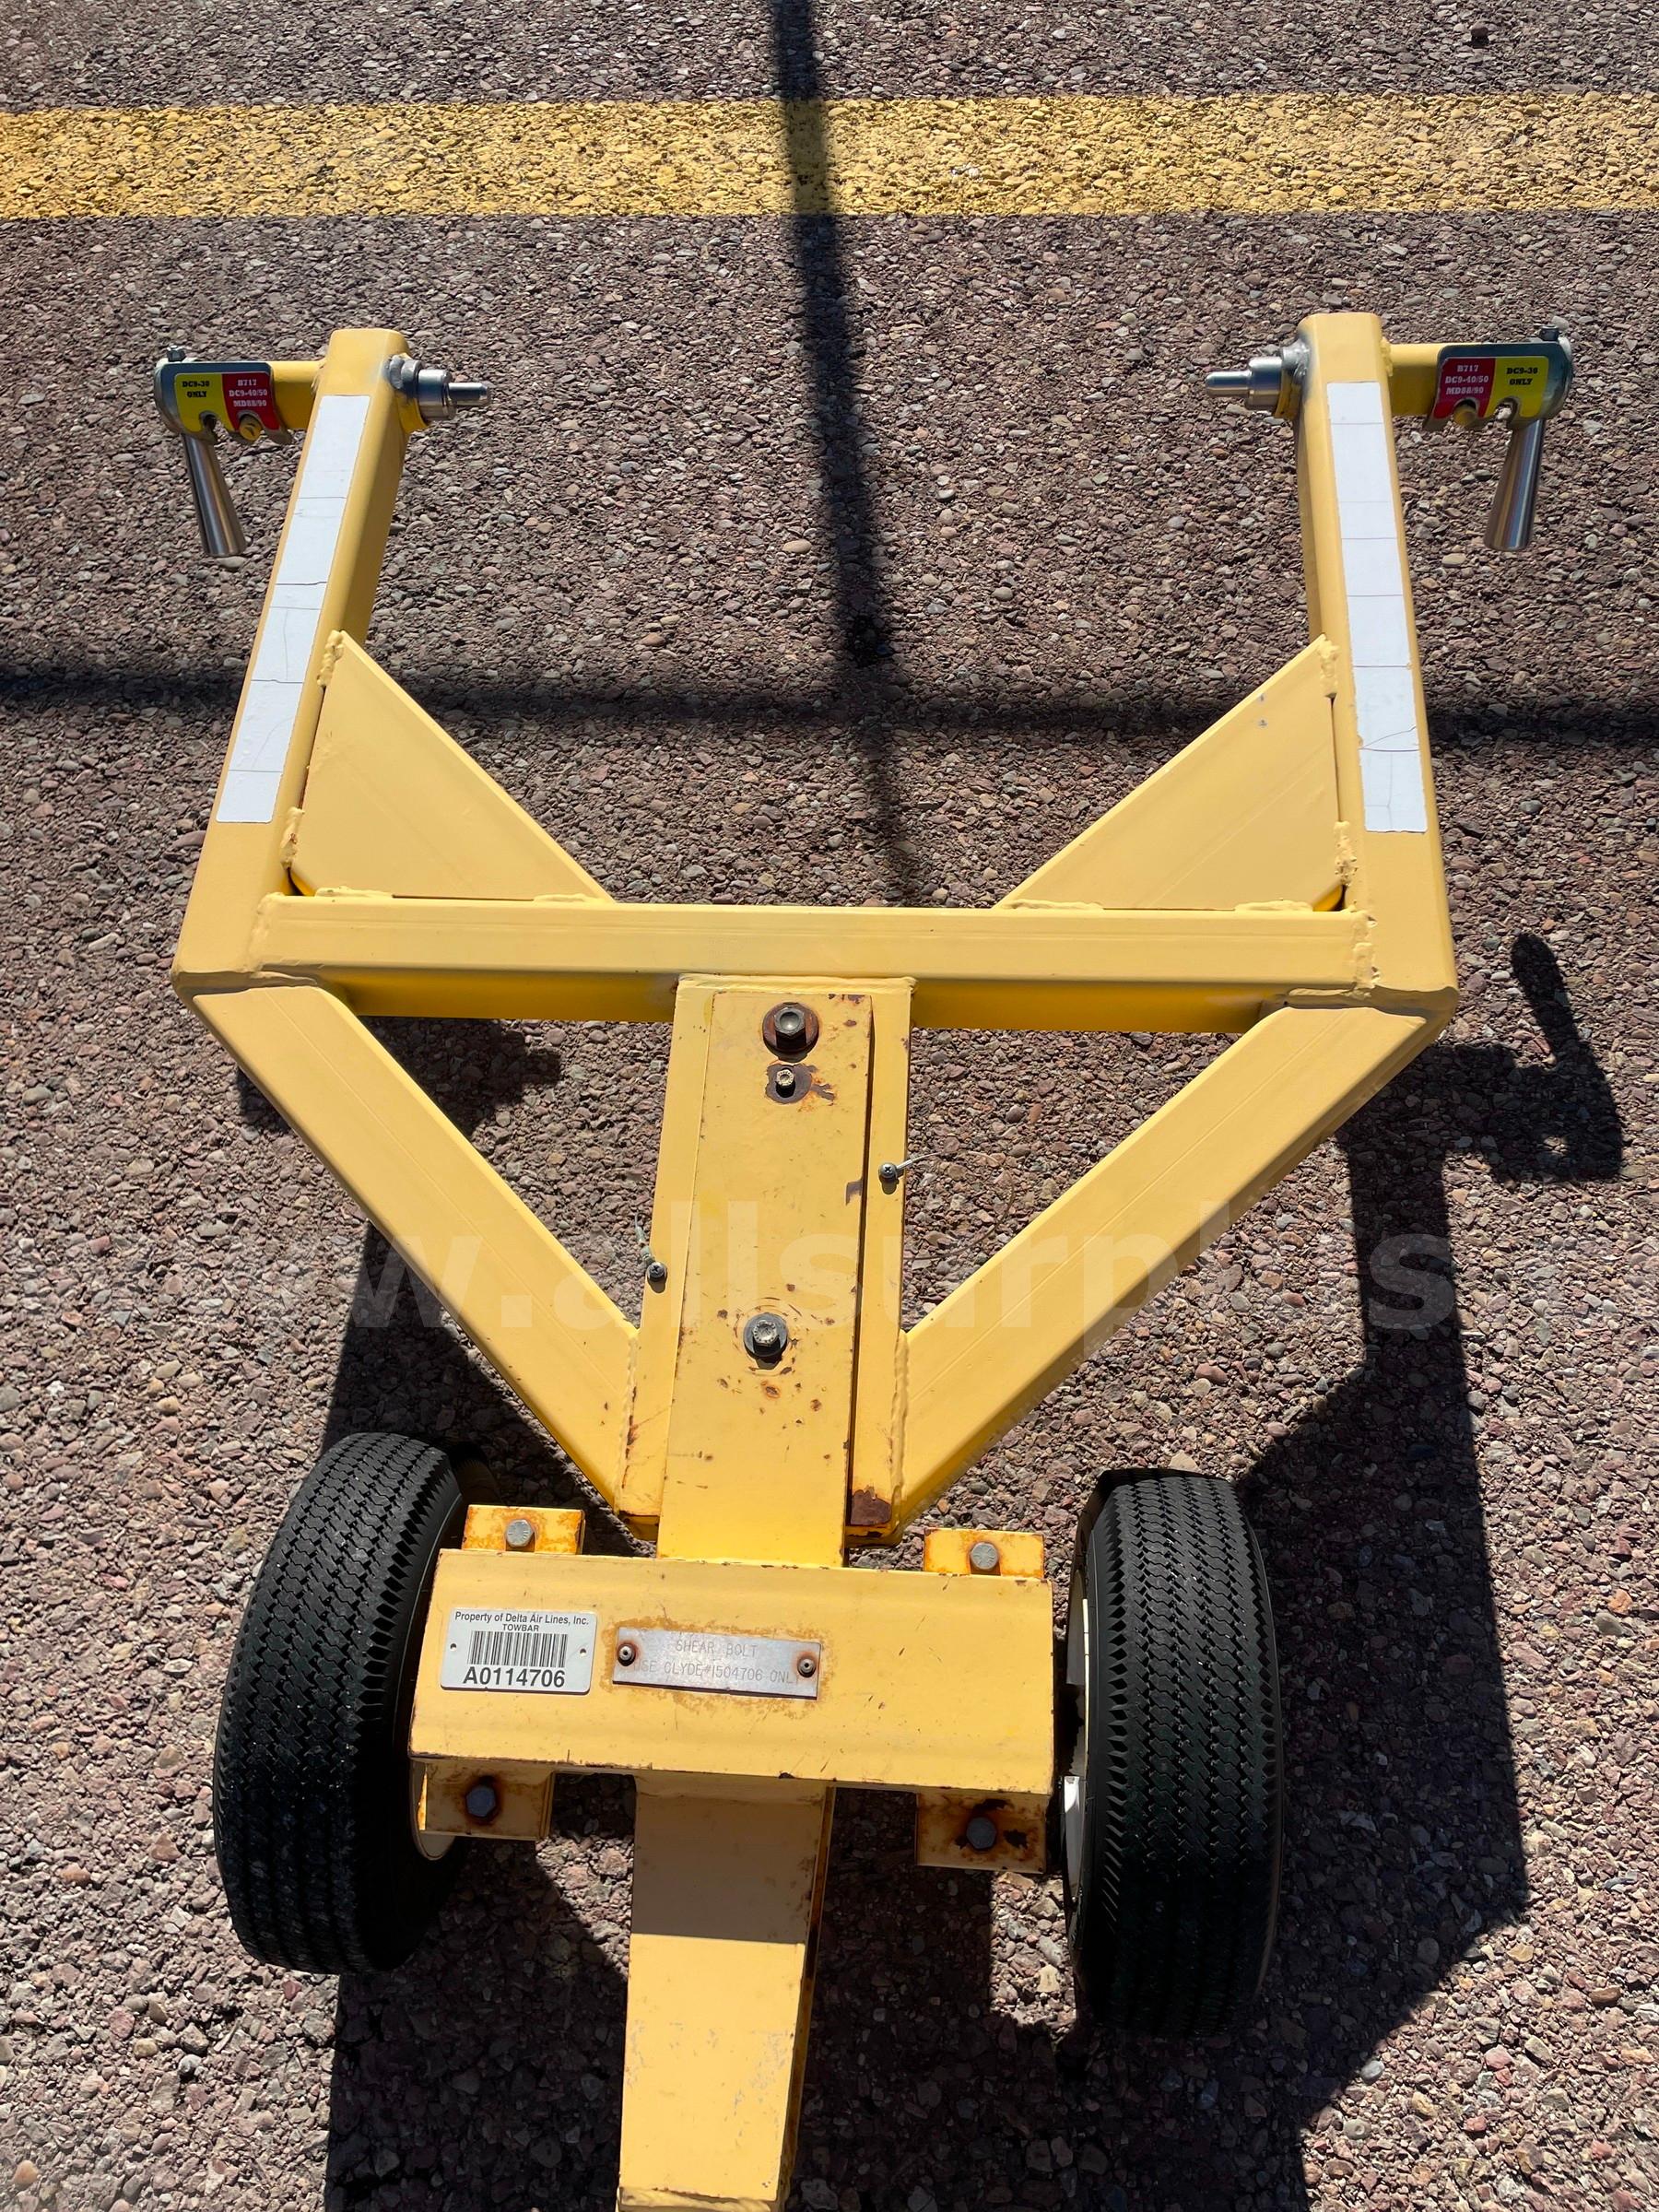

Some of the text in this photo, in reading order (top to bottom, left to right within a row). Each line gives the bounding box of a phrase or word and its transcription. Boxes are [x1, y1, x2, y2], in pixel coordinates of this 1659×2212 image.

[1457, 364, 1479, 372] B717
[1445, 375, 1489, 383] DC9-40/50
[229, 389, 267, 397] DC9-40/50
[454, 1611, 590, 1625] Property of Delta Air Lines, Inc.
[502, 1624, 540, 1632] TOWBAR
[676, 1639, 759, 1658] SHEAR BOLT
[463, 1666, 566, 1688] A0114706
